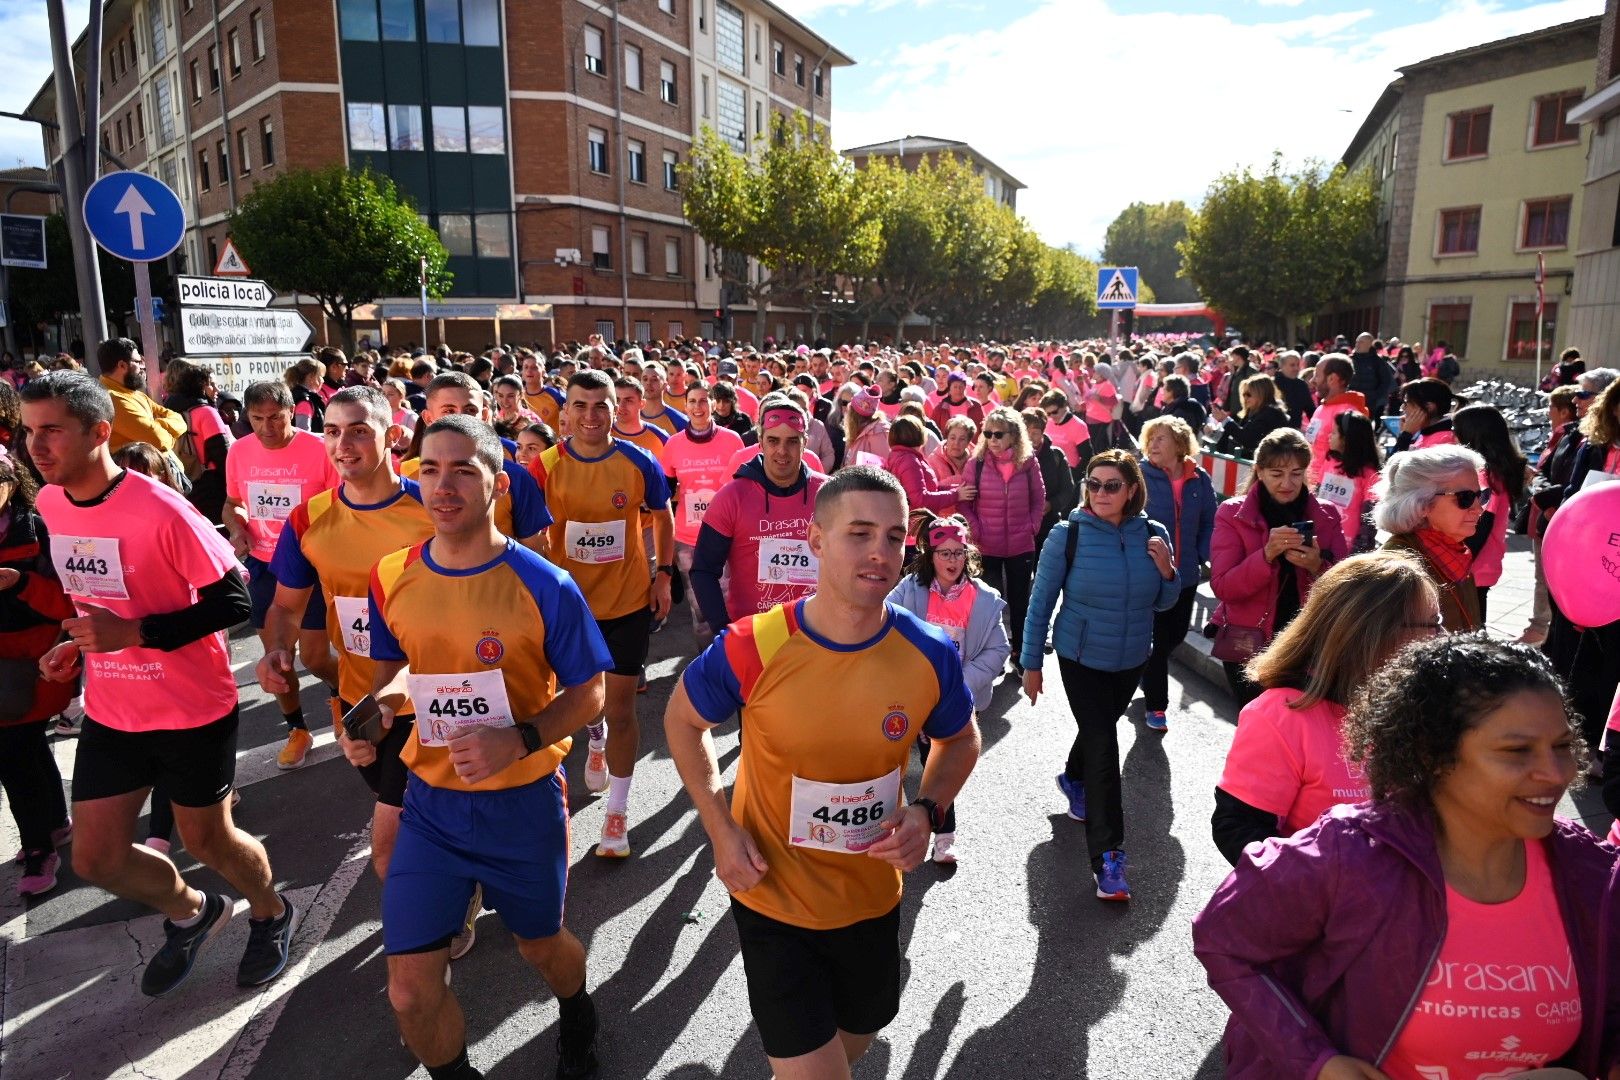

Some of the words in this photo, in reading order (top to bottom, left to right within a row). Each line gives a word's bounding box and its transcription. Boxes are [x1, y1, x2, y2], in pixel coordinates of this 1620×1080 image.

[234, 284, 266, 301] local
[249, 360, 297, 374] PROVINC
[257, 495, 291, 507] 3473
[694, 502, 710, 511] 50
[577, 535, 615, 547] 4459
[65, 557, 108, 575] 4443
[770, 553, 809, 567] 4378
[352, 617, 371, 633] 44
[128, 662, 163, 673] MUJER
[428, 697, 490, 717] 4456
[812, 801, 884, 826] 4486
[1464, 1051, 1549, 1063] SUZUKI
